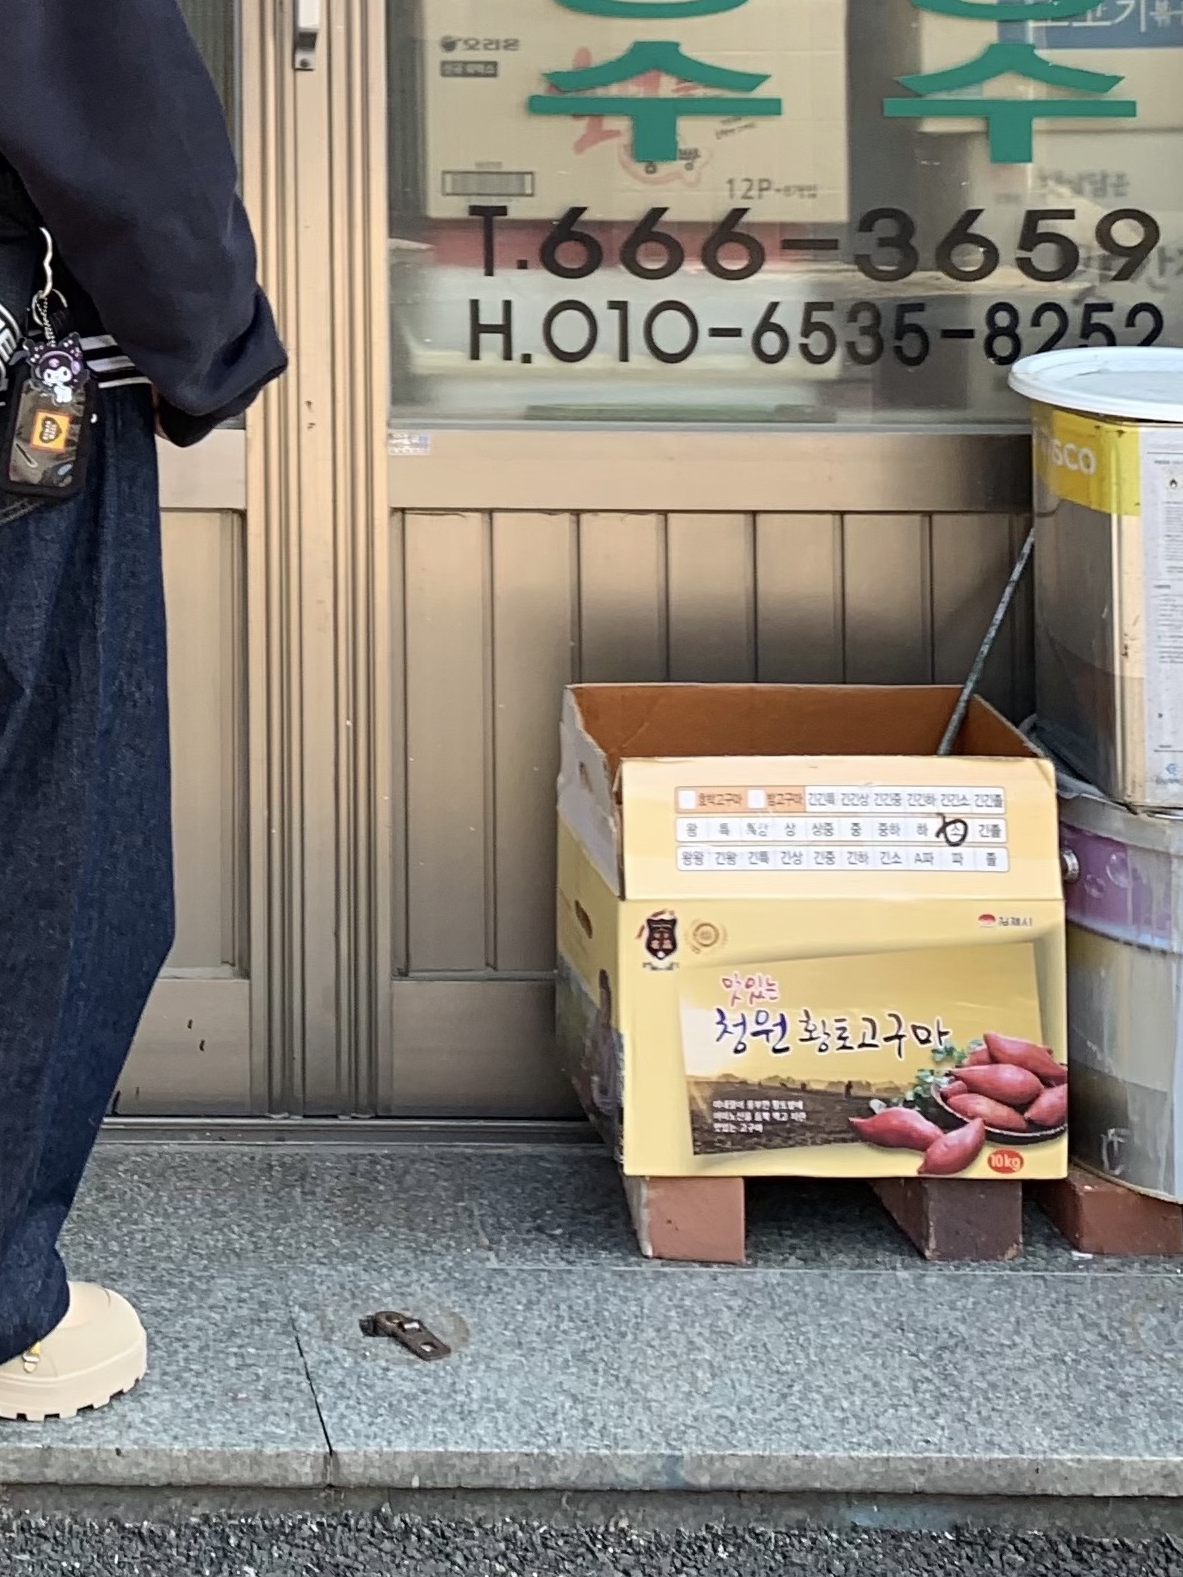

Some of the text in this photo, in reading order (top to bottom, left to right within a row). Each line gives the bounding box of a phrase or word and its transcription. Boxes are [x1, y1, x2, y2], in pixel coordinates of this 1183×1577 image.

[462, 38, 520, 50] 오리온
[469, 207, 1161, 282] T.666-3659
[468, 299, 1164, 366] H.010-6535-8252
[785, 822, 796, 837] 상
[851, 822, 862, 837] 중
[721, 973, 779, 1007] 맛있는
[714, 1007, 951, 1059] 청원 황토고구마
[990, 1153, 1021, 1172] 10kg
